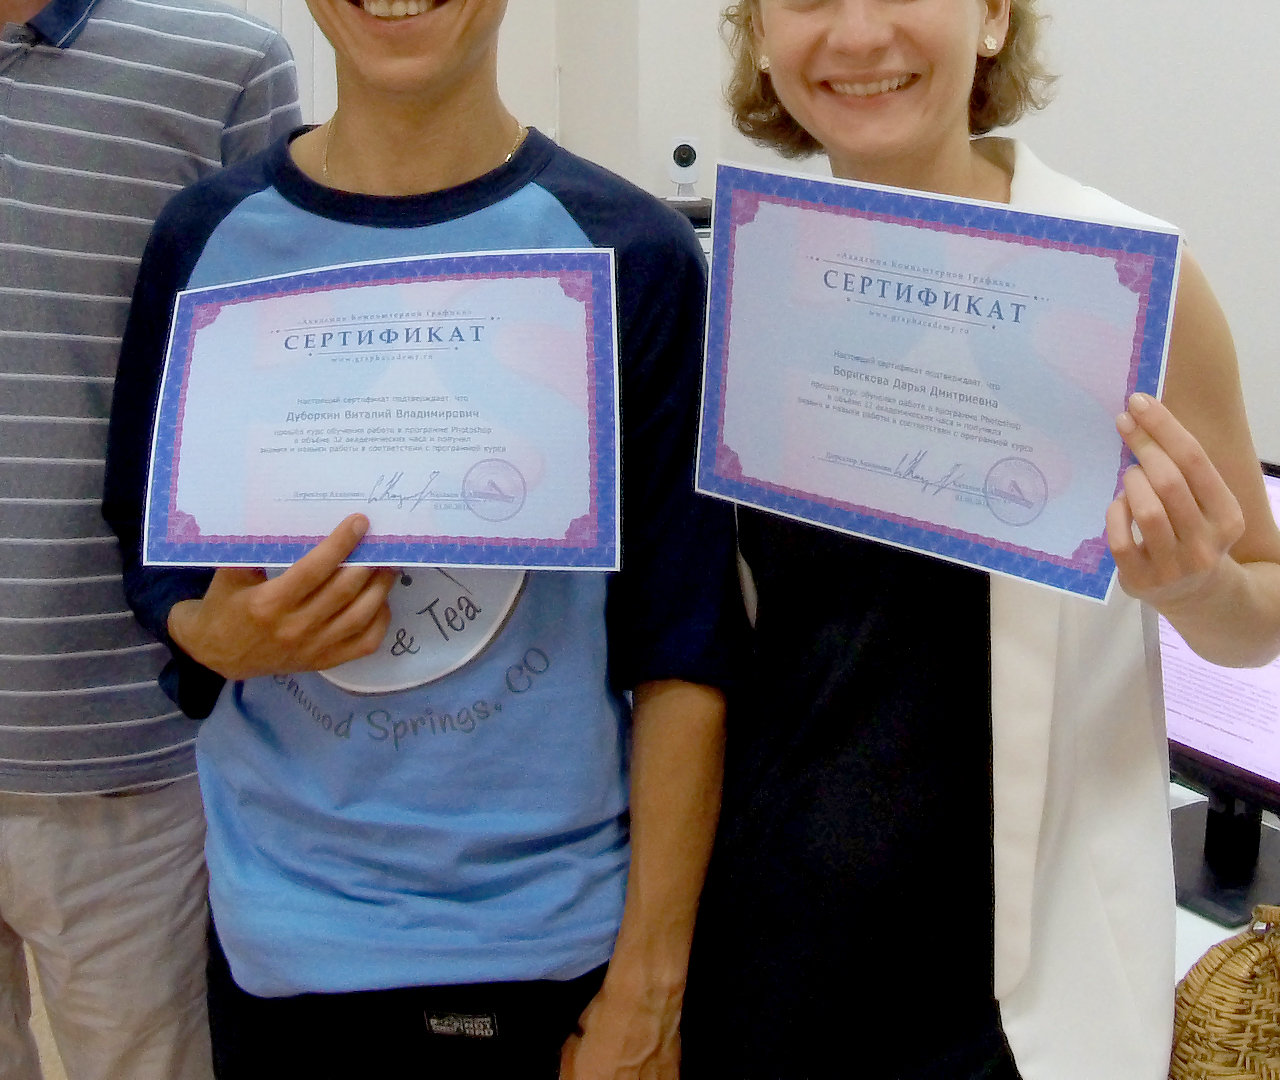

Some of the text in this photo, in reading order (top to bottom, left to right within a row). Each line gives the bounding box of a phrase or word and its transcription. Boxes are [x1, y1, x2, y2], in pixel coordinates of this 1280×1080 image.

[823, 269, 1027, 324] СЕРТИФИКАТ
[284, 325, 485, 350] СЕРТИФИКАТ
[833, 365, 999, 409] Борискова Дарья Дмитриевна
[286, 408, 480, 423] Дуборкин Виталий Владимирович
[390, 595, 482, 657] & Tea
[505, 647, 550, 693] CO
